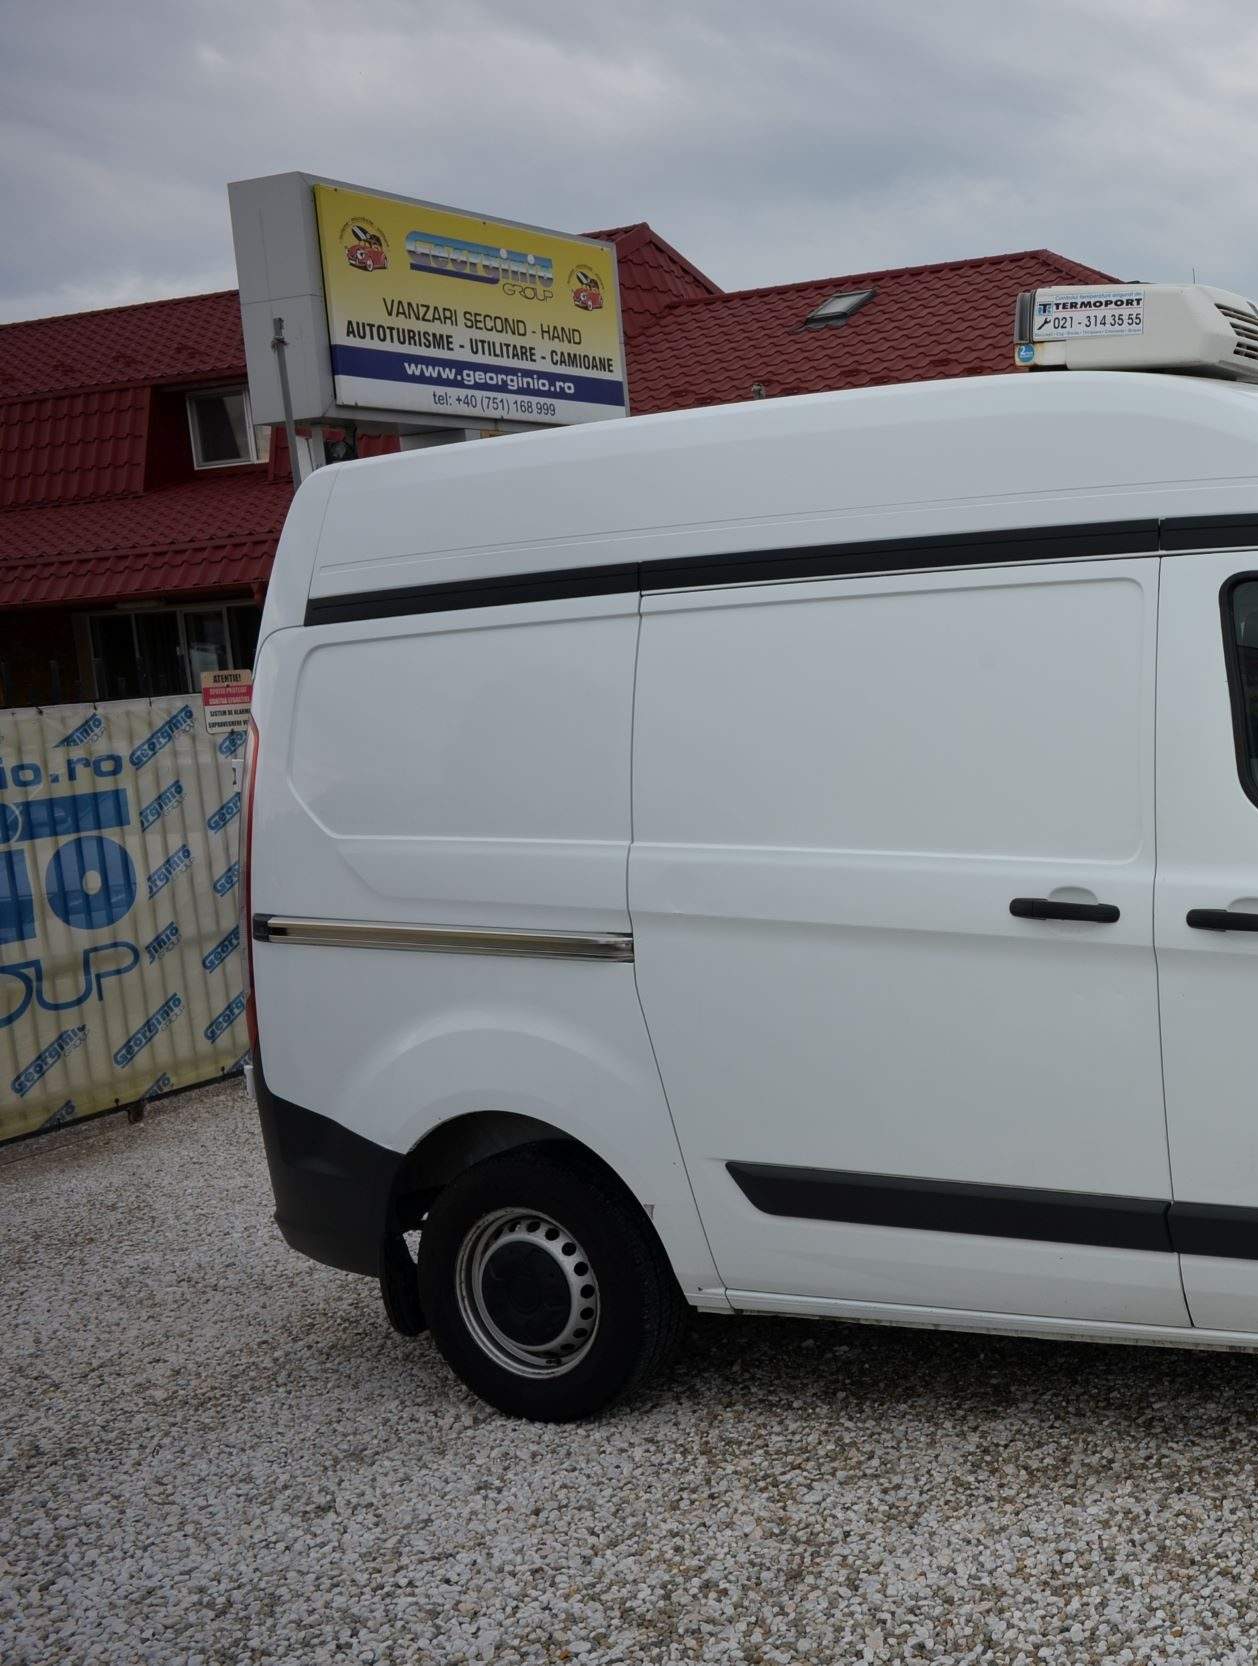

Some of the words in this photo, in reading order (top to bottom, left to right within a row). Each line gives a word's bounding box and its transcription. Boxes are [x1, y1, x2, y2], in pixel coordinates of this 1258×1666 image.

[502, 282, 553, 302] GROUP
[1054, 298, 1142, 310] TERMOPORT
[383, 297, 458, 327] VANZARI
[463, 311, 527, 337] SECOND
[540, 323, 582, 345] HAND
[1053, 316, 1073, 329] 021
[1085, 314, 1106, 328] 314
[1109, 313, 1124, 327] 35
[1126, 313, 1141, 326] 55
[346, 320, 454, 351] AUTOTURISME
[469, 338, 536, 362] UTILITARE
[550, 350, 614, 373] CAMIOANE
[403, 362, 575, 394] www.georginio.ro
[433, 391, 452, 406] tel:
[455, 394, 477, 409] +40
[480, 396, 510, 414] (751)
[513, 400, 533, 415] 168
[536, 402, 556, 417] 999
[129, 705, 193, 770] Georginio
[113, 992, 182, 1069] Georginio
